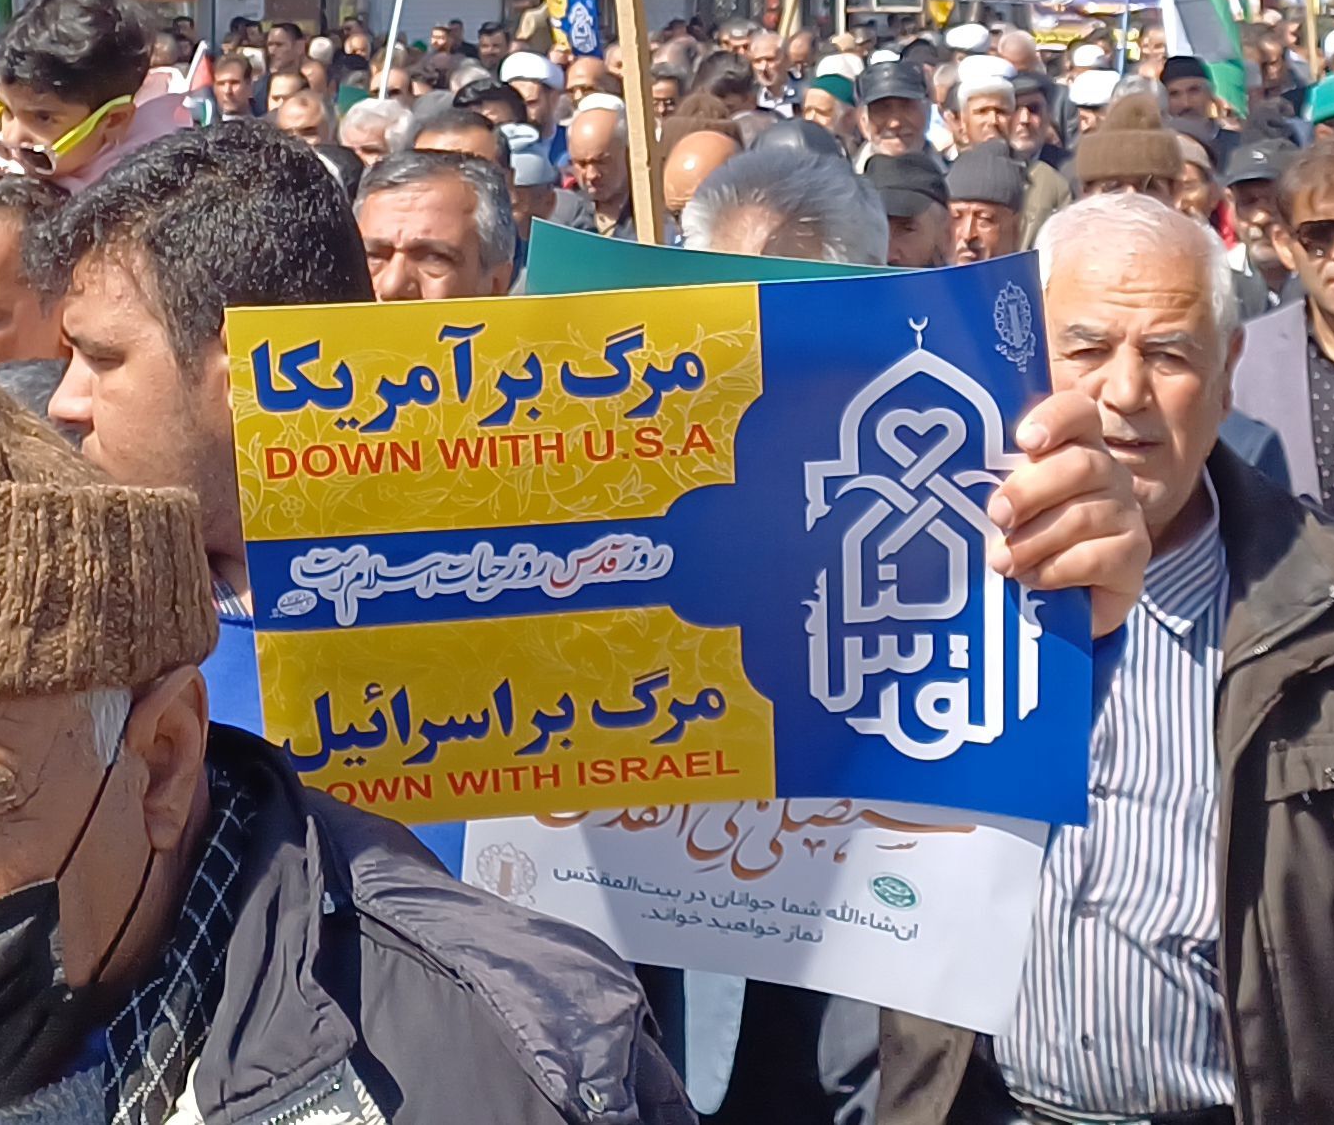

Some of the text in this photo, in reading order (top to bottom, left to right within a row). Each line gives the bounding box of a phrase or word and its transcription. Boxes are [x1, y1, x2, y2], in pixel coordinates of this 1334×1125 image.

[251, 323, 705, 432] مرگ بر آمریکا
[265, 423, 716, 480] DOWN WITH U.S.A
[299, 552, 360, 593] است
[437, 549, 505, 593] حیات
[503, 551, 548, 581] روز
[550, 542, 628, 588] قدس
[620, 542, 666, 573] روز
[344, 560, 443, 617] اسلام
[283, 667, 727, 773] مرگ بر اسرائیل
[324, 750, 740, 806] OWN WITH ISRAEL
[684, 889, 707, 904] در
[711, 889, 775, 915] جوانان
[781, 896, 820, 917] شما
[641, 906, 823, 943] نماز خواهید خواند.
